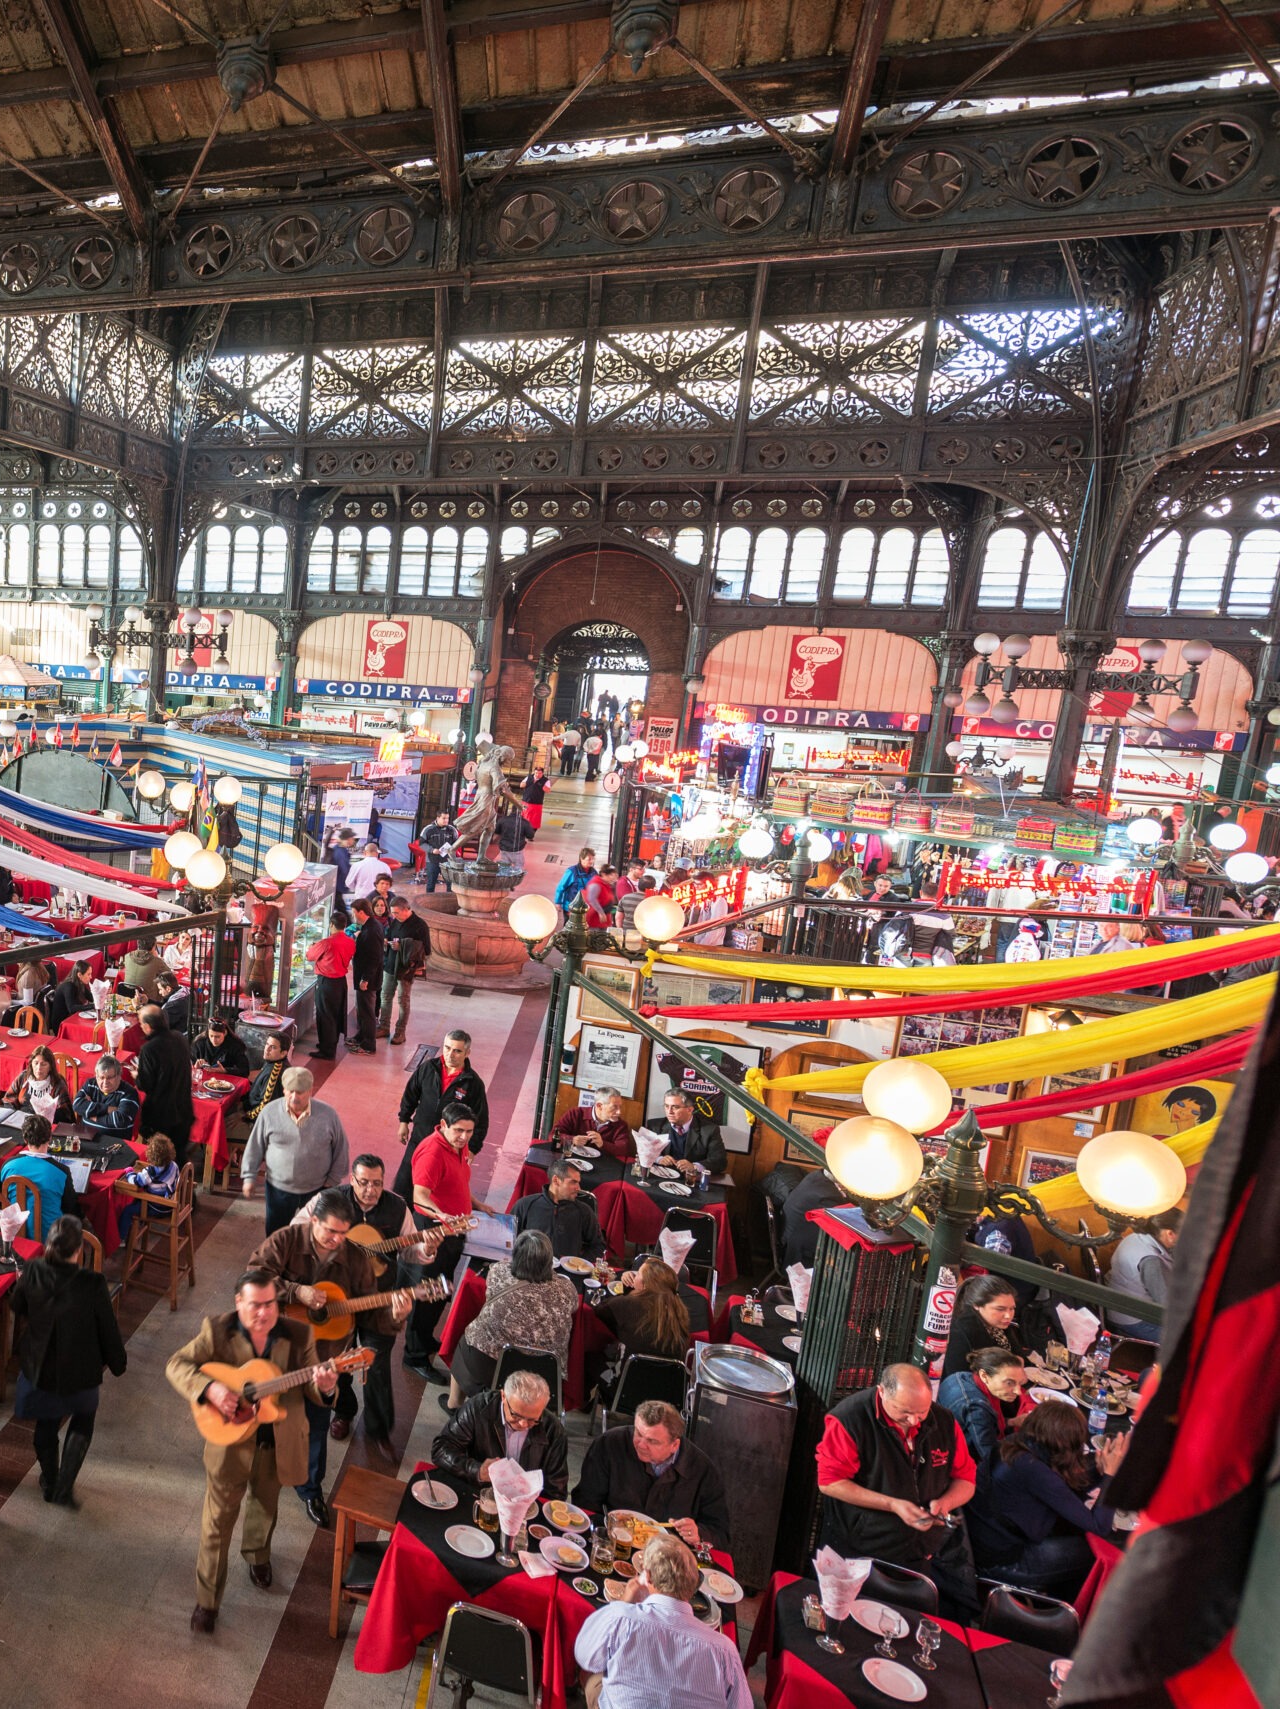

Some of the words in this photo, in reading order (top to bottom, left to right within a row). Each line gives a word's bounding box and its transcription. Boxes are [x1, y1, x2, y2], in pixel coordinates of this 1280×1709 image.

[371, 629, 404, 639] CODIPRA
[797, 645, 841, 656] CODIPRA
[138, 671, 231, 688] CDIPRA
[325, 682, 431, 699] CODIPRA
[762, 708, 871, 728] ODIPRA
[650, 726, 674, 734] POLLOS
[683, 1082, 718, 1093] SORIANA
